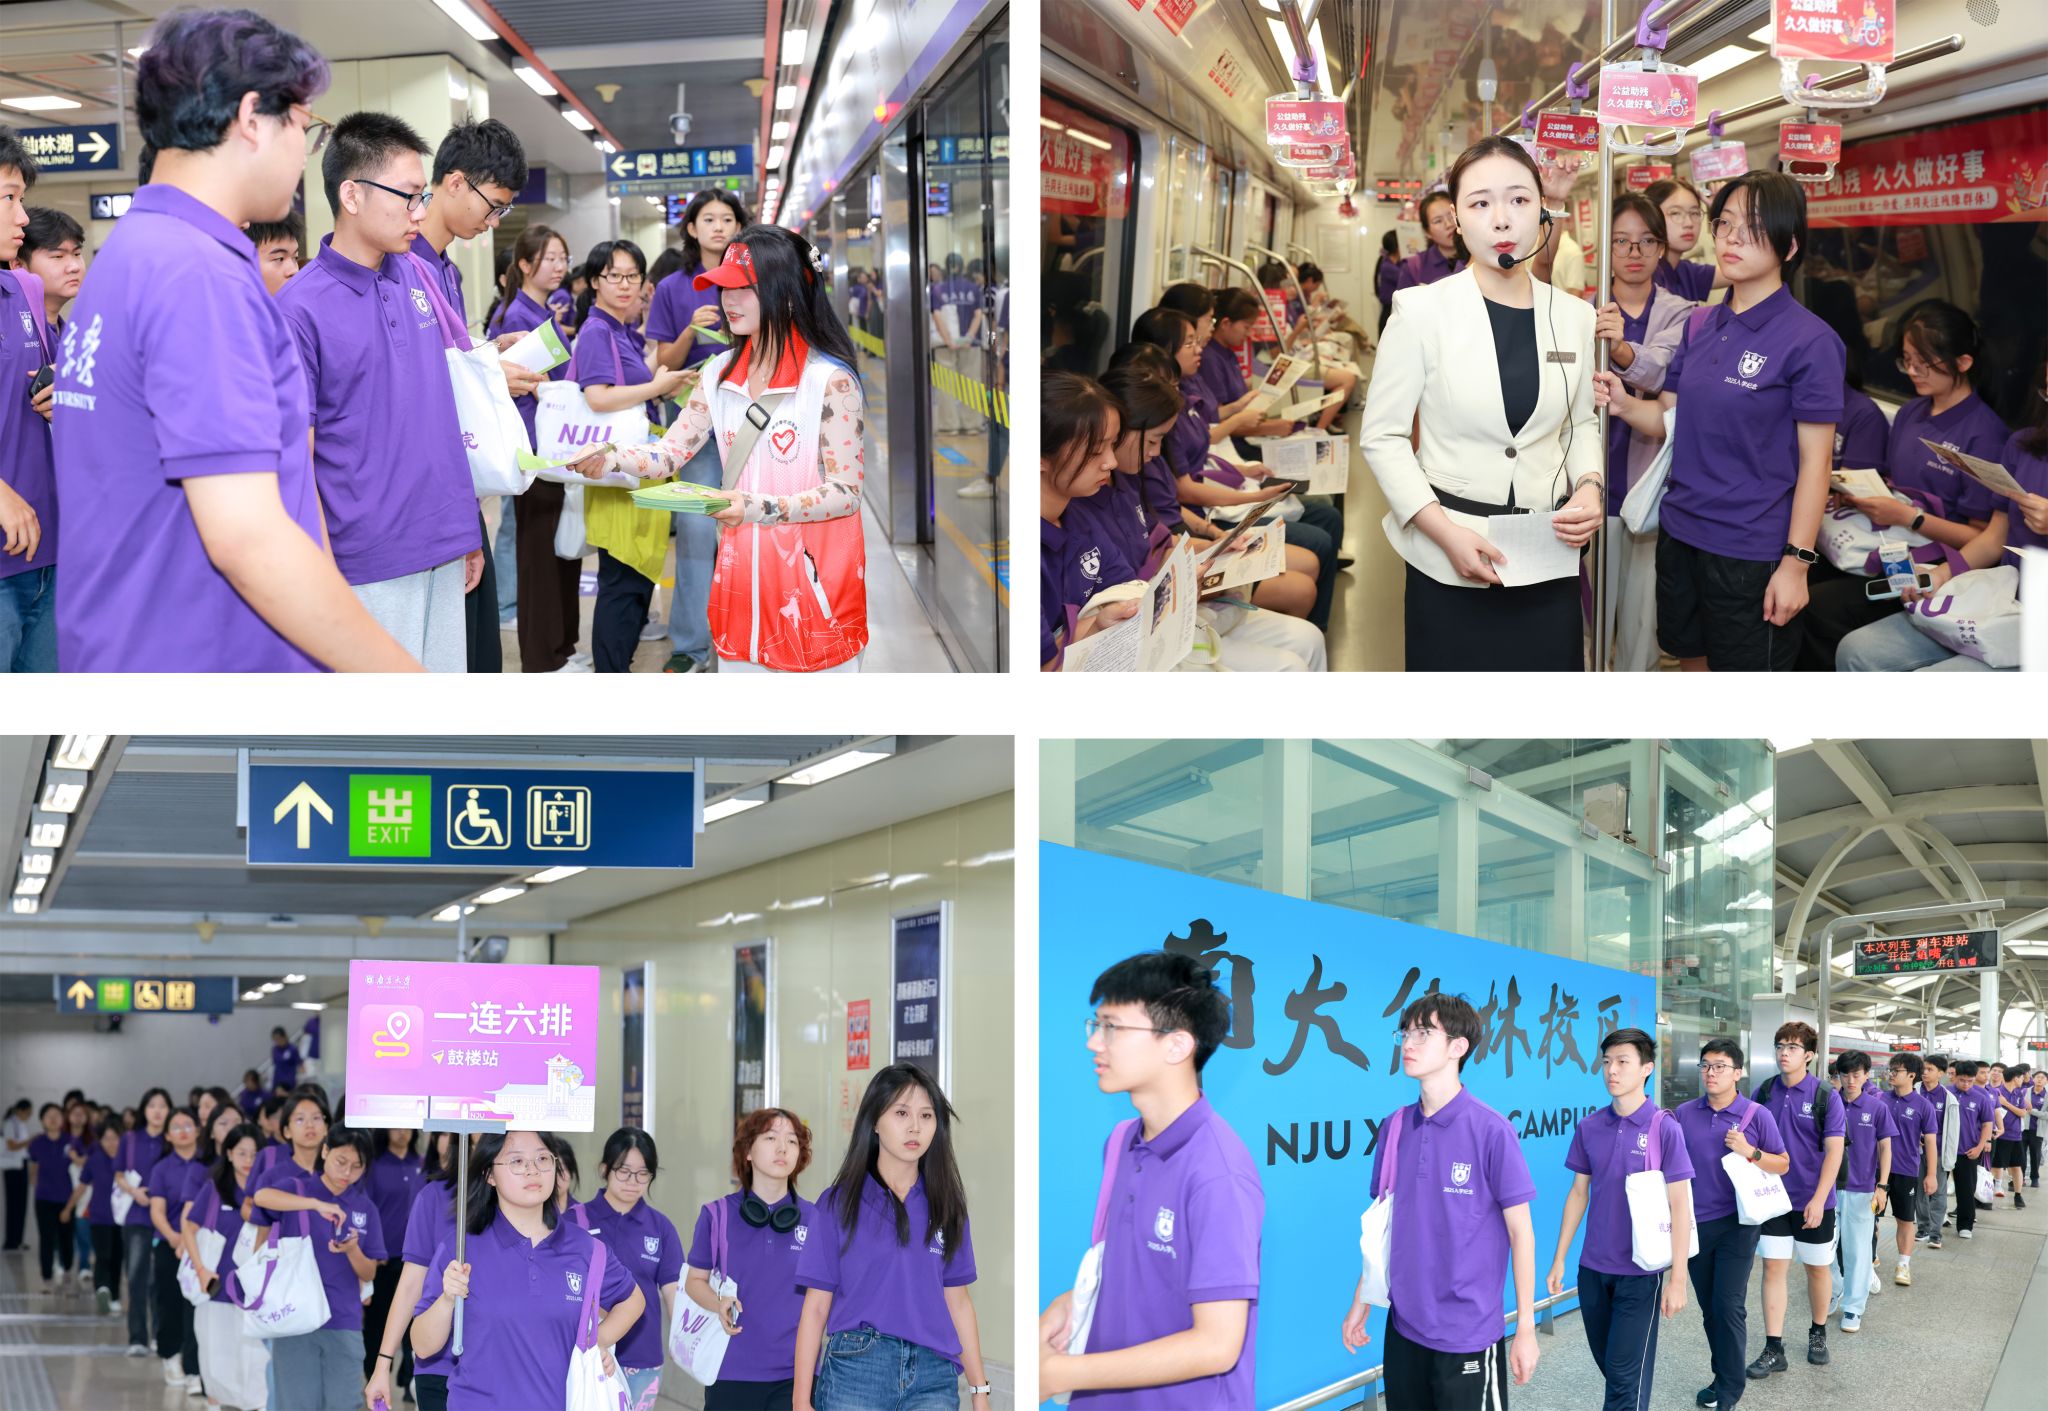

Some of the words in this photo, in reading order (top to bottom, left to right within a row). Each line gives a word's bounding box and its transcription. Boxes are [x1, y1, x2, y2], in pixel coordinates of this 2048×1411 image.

[1784, 15, 1844, 35] 久久做好事
[1612, 85, 1649, 97] 公益助残
[1607, 98, 1653, 109] 久久做好事
[1276, 112, 1307, 121] 公益助残
[1273, 123, 1311, 131] 久久做好事
[1873, 150, 1986, 192] 久久做好事
[557, 423, 613, 446] NJU
[367, 787, 413, 824] 出
[367, 826, 412, 844] EXIT
[1864, 940, 1911, 954] 本次列车
[1916, 934, 1968, 949] 列车进站
[1887, 951, 1913, 963] 开往
[1938, 959, 1955, 968] 开往
[433, 1000, 573, 1038] 一连六排
[447, 1048, 499, 1068] 鼓楼站
[1267, 1119, 1351, 1166] NJU
